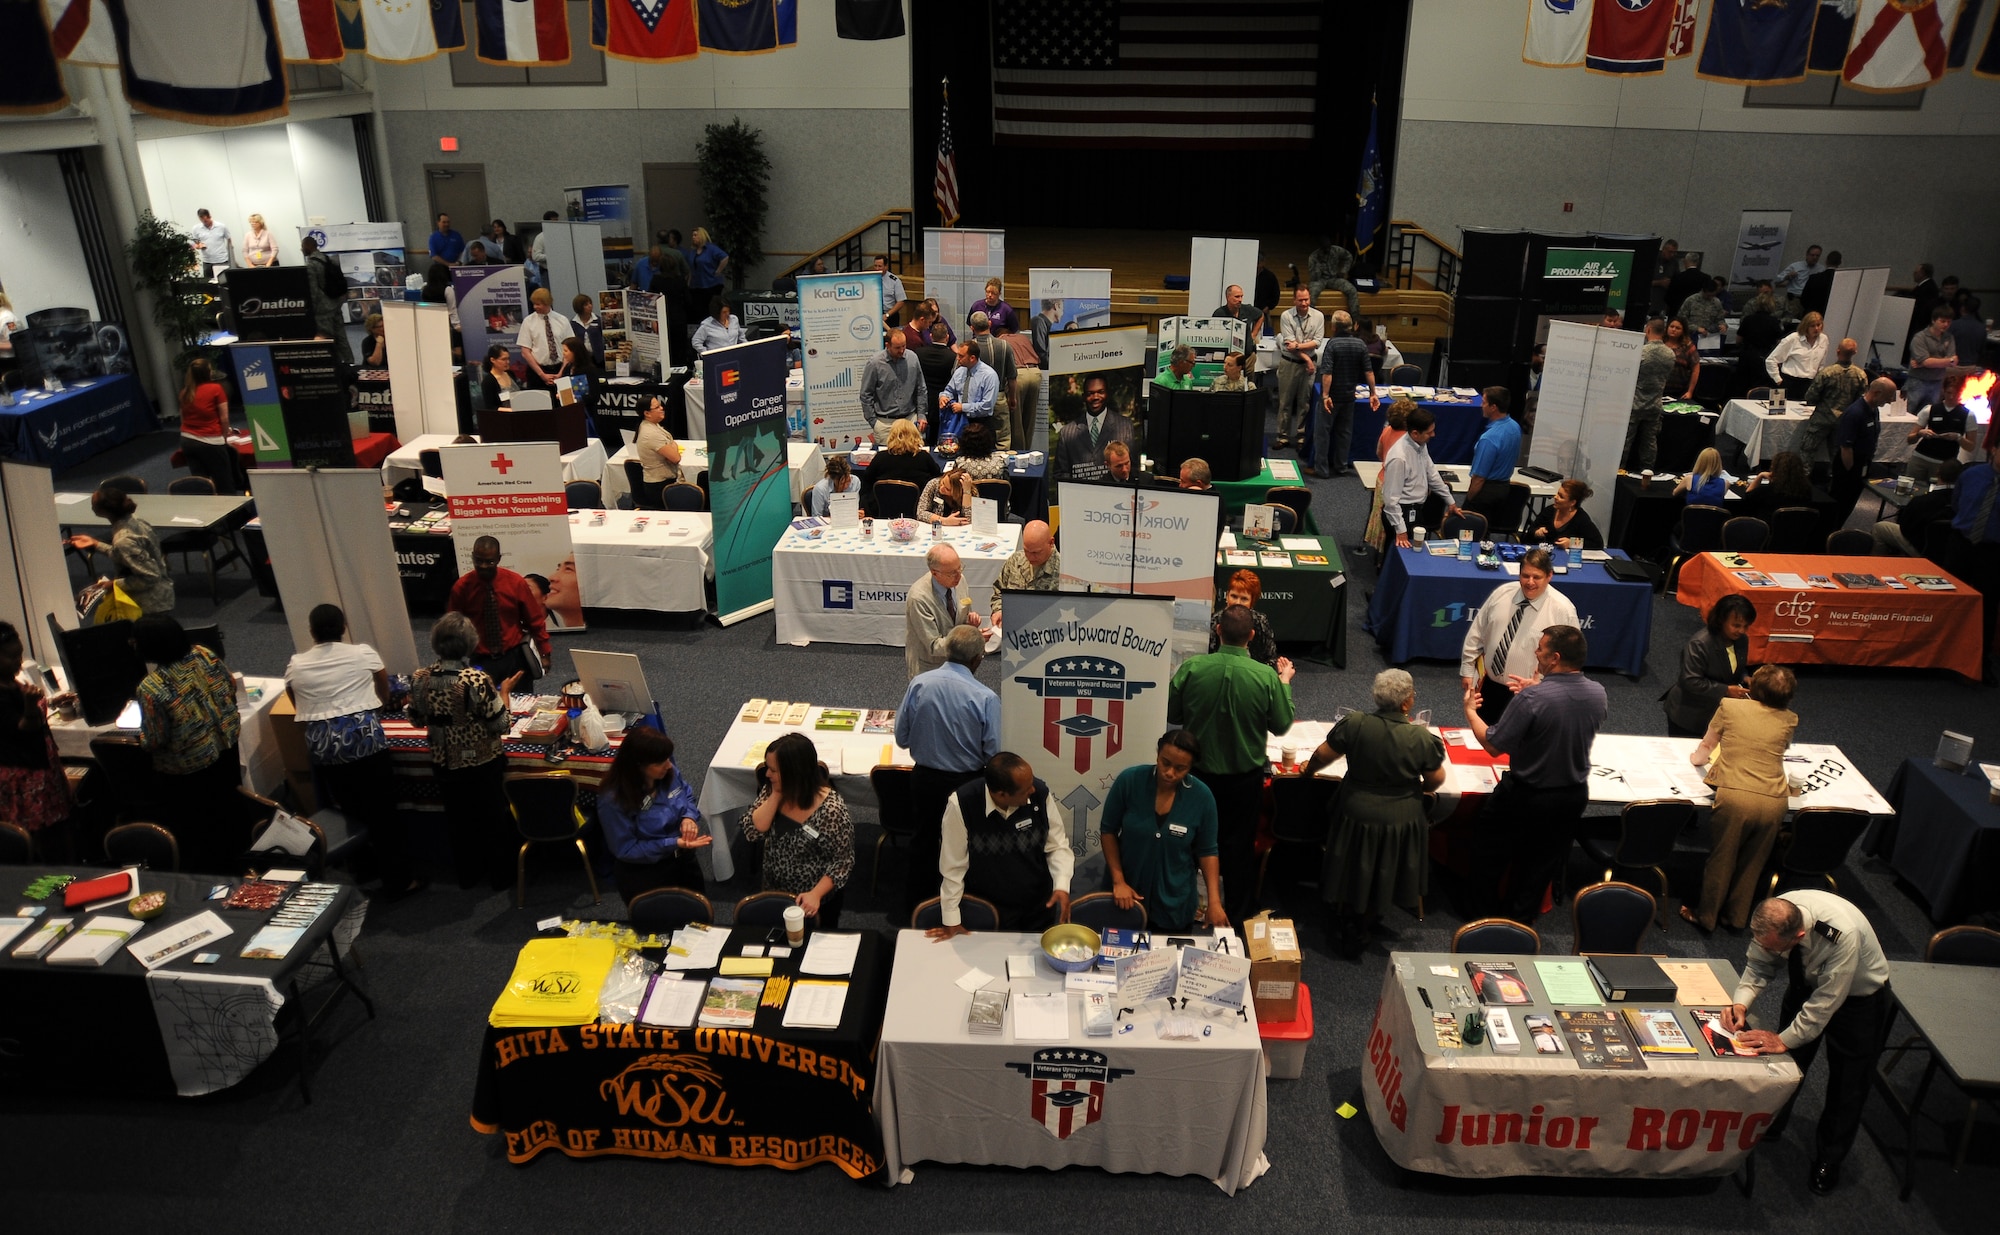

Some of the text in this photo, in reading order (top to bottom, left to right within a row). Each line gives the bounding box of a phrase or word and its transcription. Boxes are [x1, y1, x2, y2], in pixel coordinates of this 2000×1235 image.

[1550, 268, 1599, 276] PRODUCTS
[1609, 289, 1622, 297] ind
[745, 304, 779, 316] USDA
[752, 394, 783, 408] Career
[59, 400, 132, 436] AIR FORCE RESERVE
[597, 409, 620, 417] ustries
[725, 405, 784, 427] Opportunities
[477, 497, 496, 505] Part
[498, 496, 509, 504] Of
[512, 495, 561, 504] Something
[454, 505, 548, 517] Bigger Than Yourself
[1259, 592, 1294, 600] MENTS
[1775, 591, 1819, 626] cfg.
[1829, 611, 1933, 623] New England Financial
[1849, 621, 1872, 629] Company
[1007, 621, 1168, 658] Veterans Upward Bound
[1048, 680, 1122, 689] Veterans Upward Bound
[1202, 953, 1232, 965] Veterans
[1145, 966, 1168, 975] Statement
[1190, 957, 1241, 974] Upward Bound
[527, 976, 581, 994] WSU
[495, 1023, 867, 1101] HITA STATE UNIVERSIT
[1366, 999, 1775, 1153] ichita Junior ROTC
[599, 1073, 735, 1127] WSU
[504, 1120, 877, 1176] FICE OF HUMAN RESOURCES
